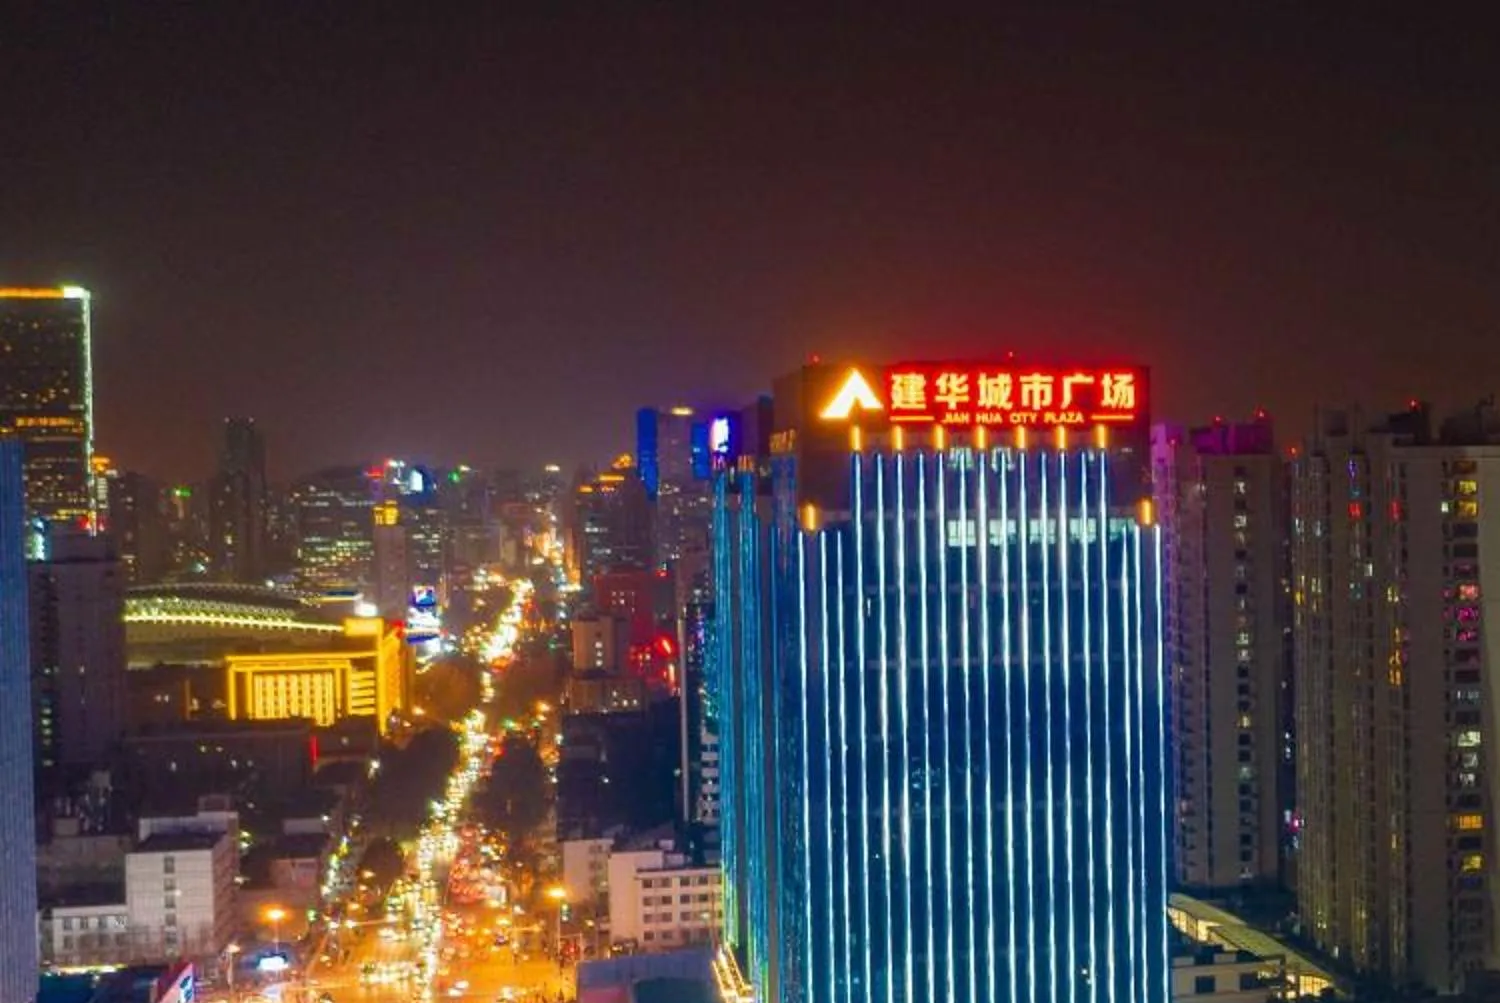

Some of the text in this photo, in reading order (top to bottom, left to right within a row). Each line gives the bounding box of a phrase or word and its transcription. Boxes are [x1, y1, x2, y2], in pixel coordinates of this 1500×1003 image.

[891, 372, 1134, 410] 建华城市广场
[942, 411, 1085, 424] JIAN HUA CITY PLAZA
